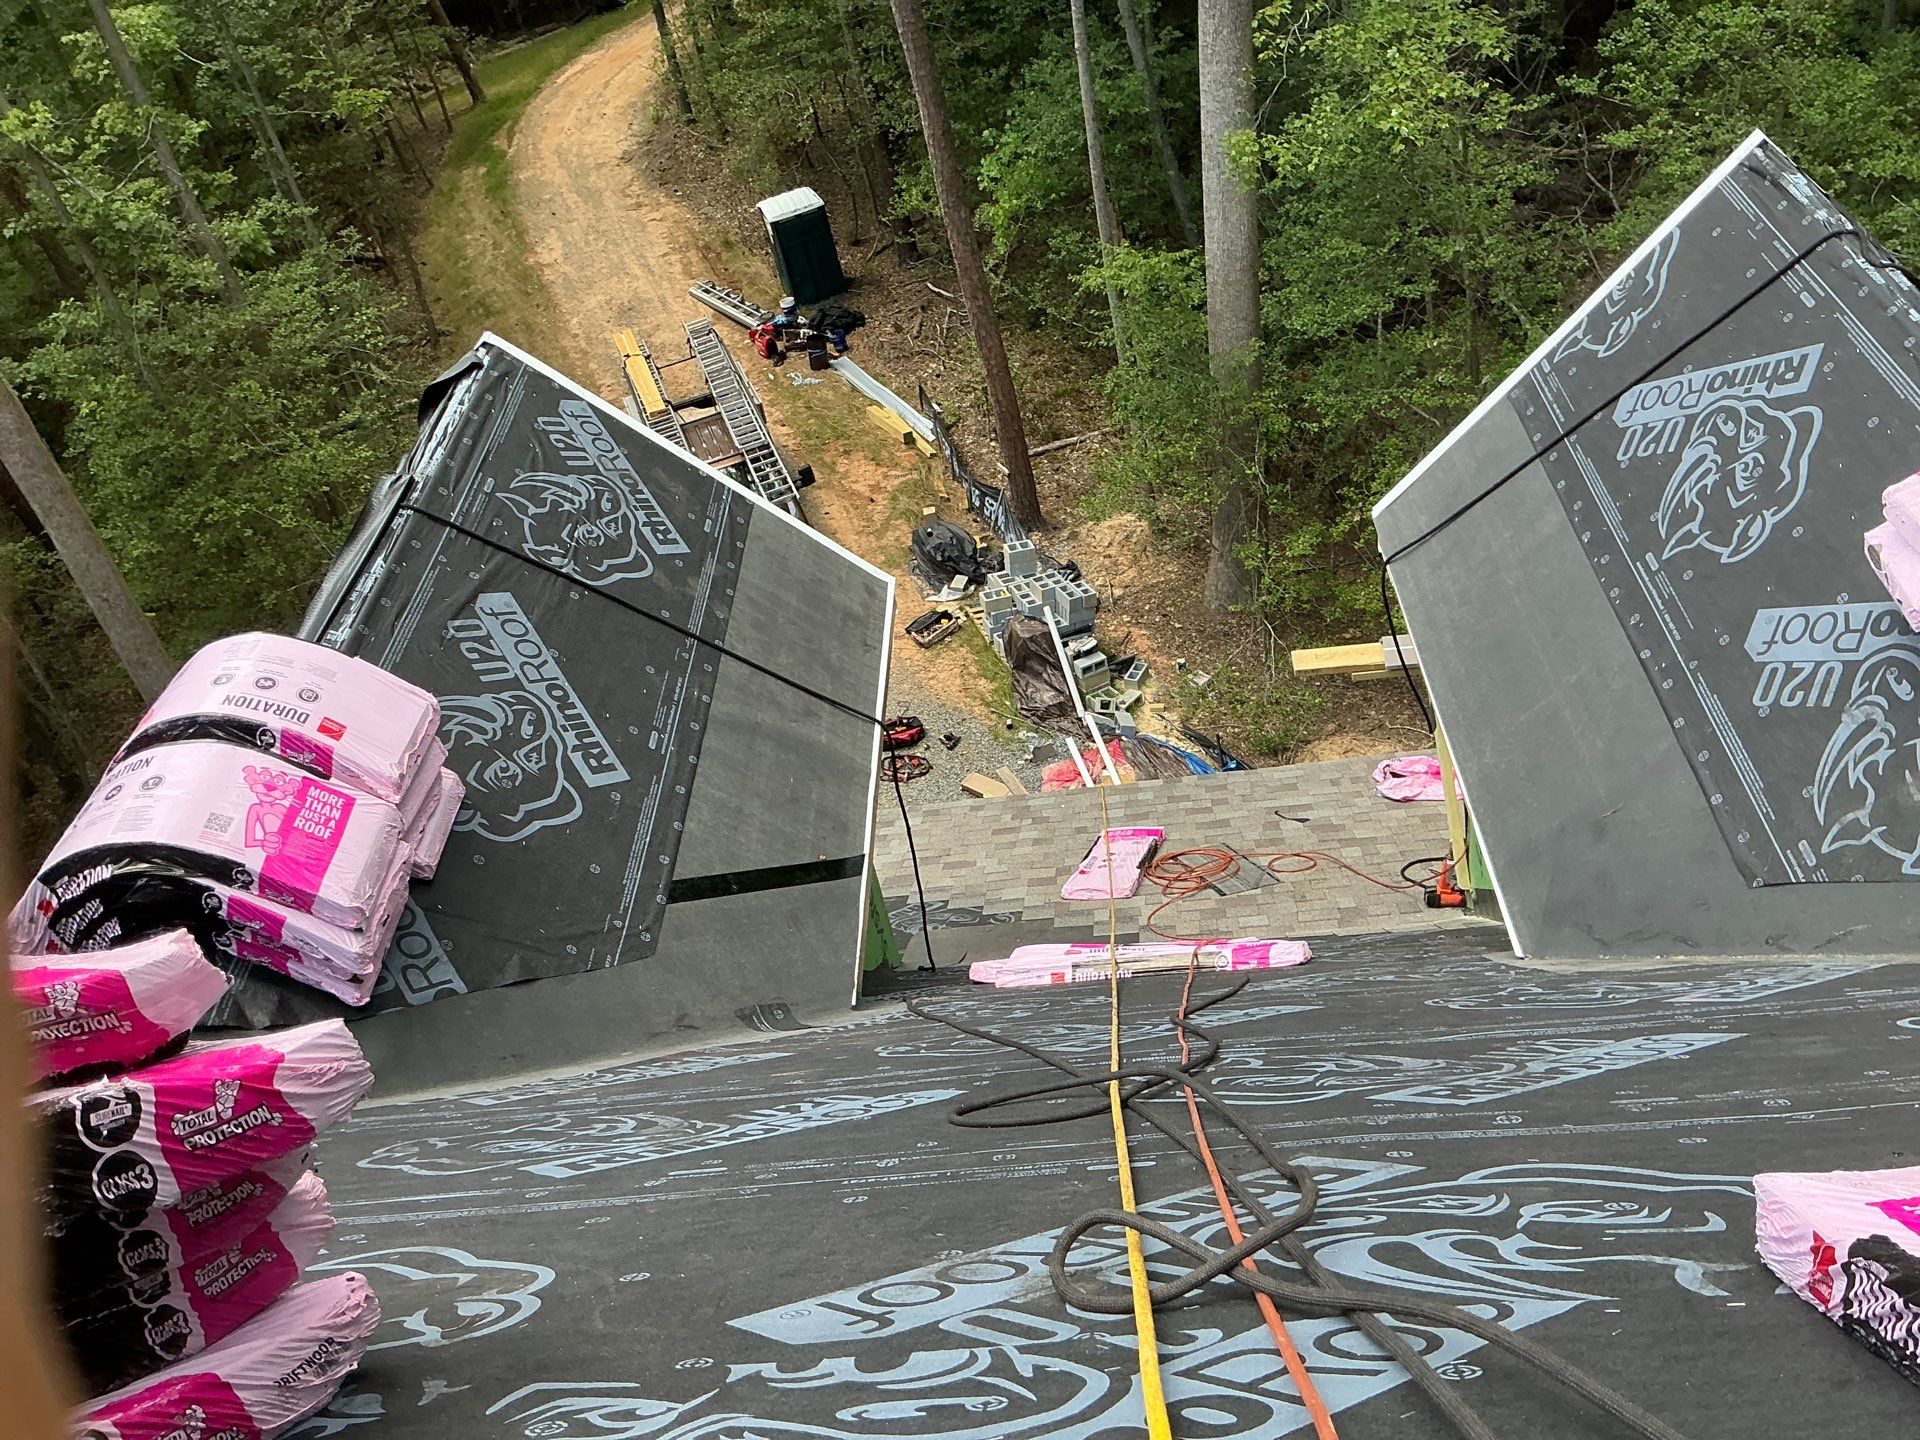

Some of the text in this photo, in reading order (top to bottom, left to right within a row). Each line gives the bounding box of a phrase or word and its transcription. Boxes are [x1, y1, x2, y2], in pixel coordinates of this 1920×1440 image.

[1623, 351, 1813, 428] RhinoRoof
[533, 415, 595, 468] U20
[1617, 413, 1687, 462] U20
[570, 405, 684, 549] RhinoRoof
[443, 617, 516, 683] U20
[1756, 607, 1913, 656] oRoof
[486, 597, 624, 784] RhinoRoof
[1752, 660, 1844, 708] U20
[221, 692, 311, 726] DURATION
[299, 807, 337, 829] JUST A
[304, 796, 342, 821] THAN
[307, 785, 345, 811] MORE
[294, 815, 335, 840] ROOF
[180, 1110, 215, 1132] TOTAL
[184, 1104, 272, 1150] PROTECTION
[135, 1163, 154, 1189] 3
